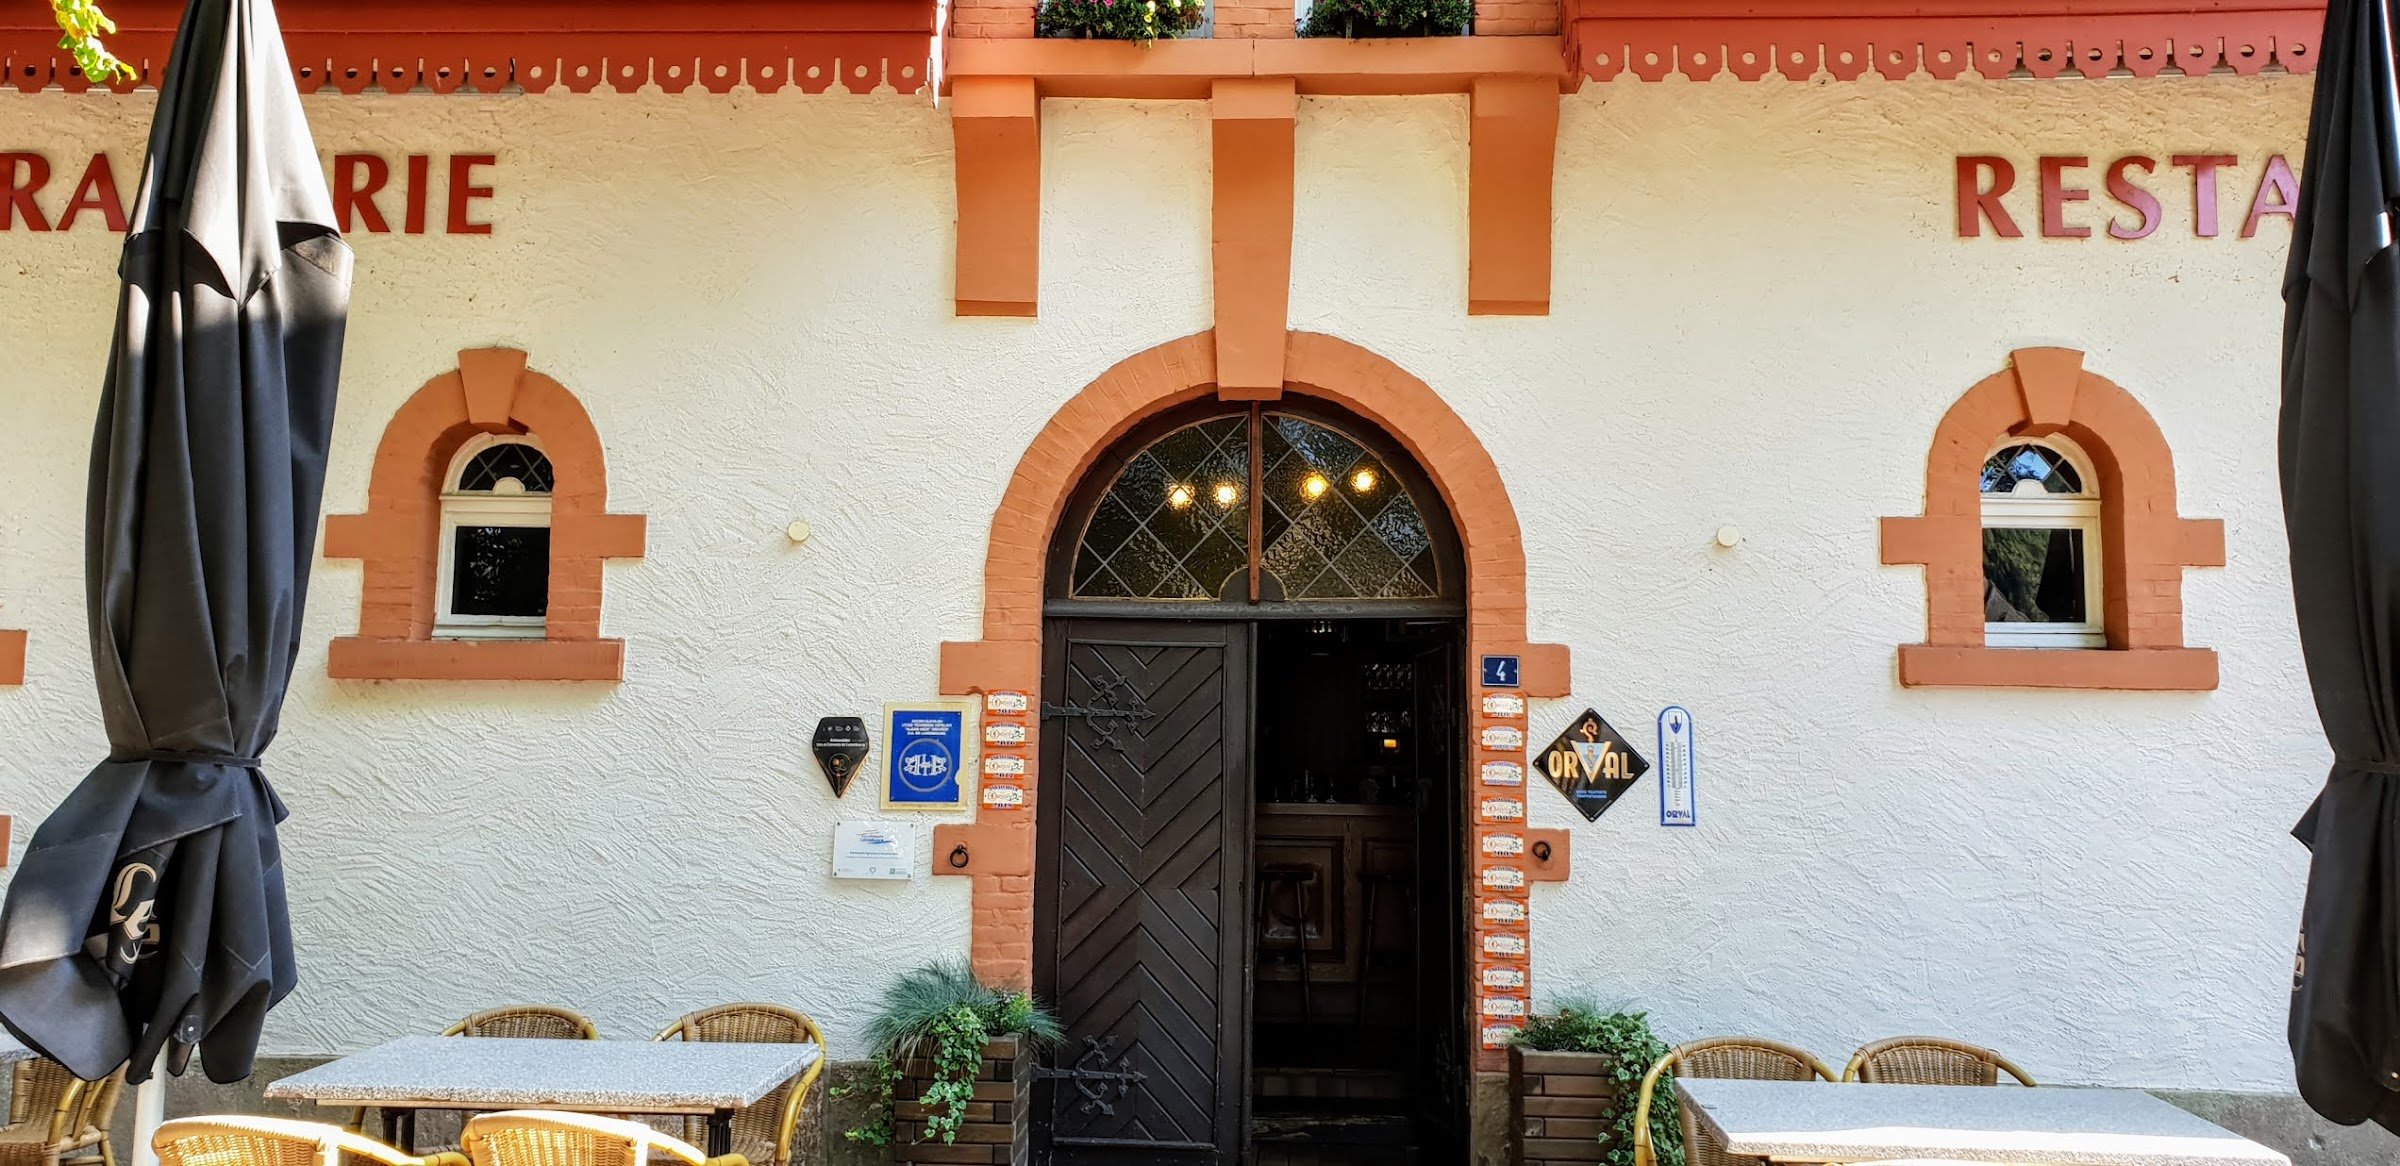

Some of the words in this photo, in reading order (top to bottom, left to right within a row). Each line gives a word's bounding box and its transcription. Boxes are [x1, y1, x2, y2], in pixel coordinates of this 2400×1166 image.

[1496, 660, 1506, 682] 4
[1547, 740, 1635, 785] ORVAL
[1666, 809, 1691, 819] ORVAL
